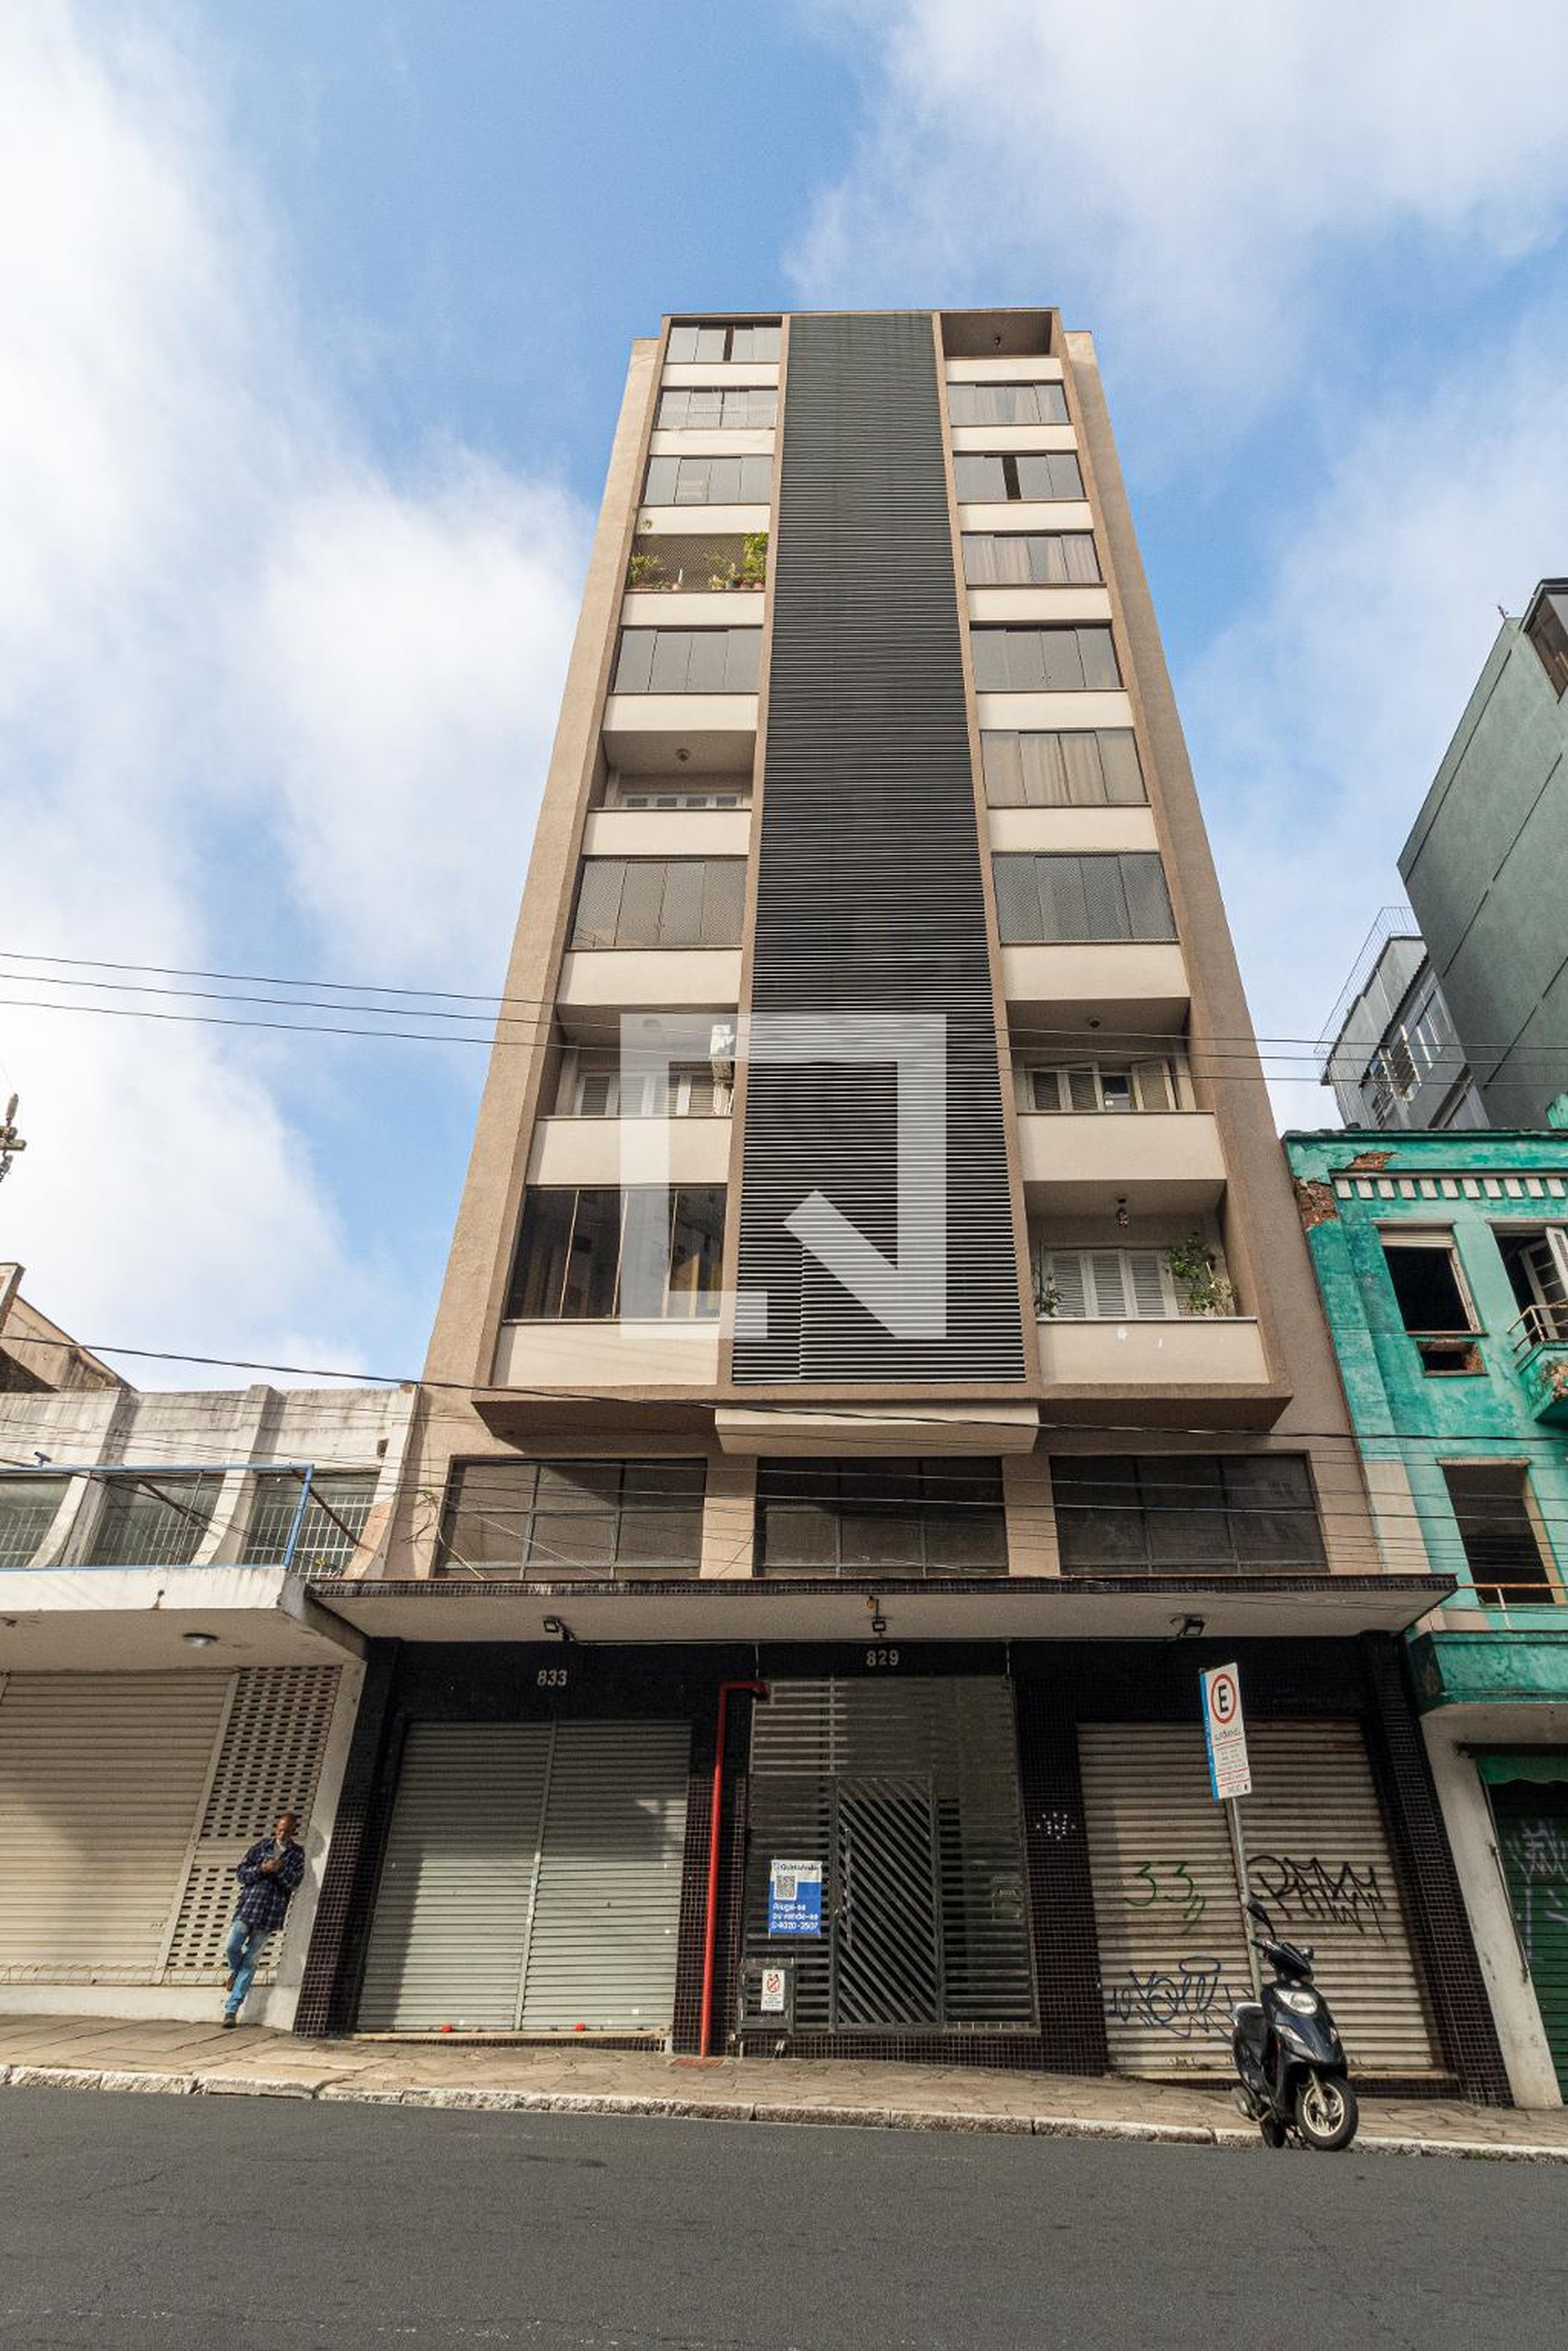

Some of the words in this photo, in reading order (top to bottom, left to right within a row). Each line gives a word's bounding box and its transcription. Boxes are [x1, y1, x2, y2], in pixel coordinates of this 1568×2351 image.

[866, 1650, 899, 1666] 829
[537, 1670, 567, 1686] 833
[1218, 1684, 1229, 1713] E
